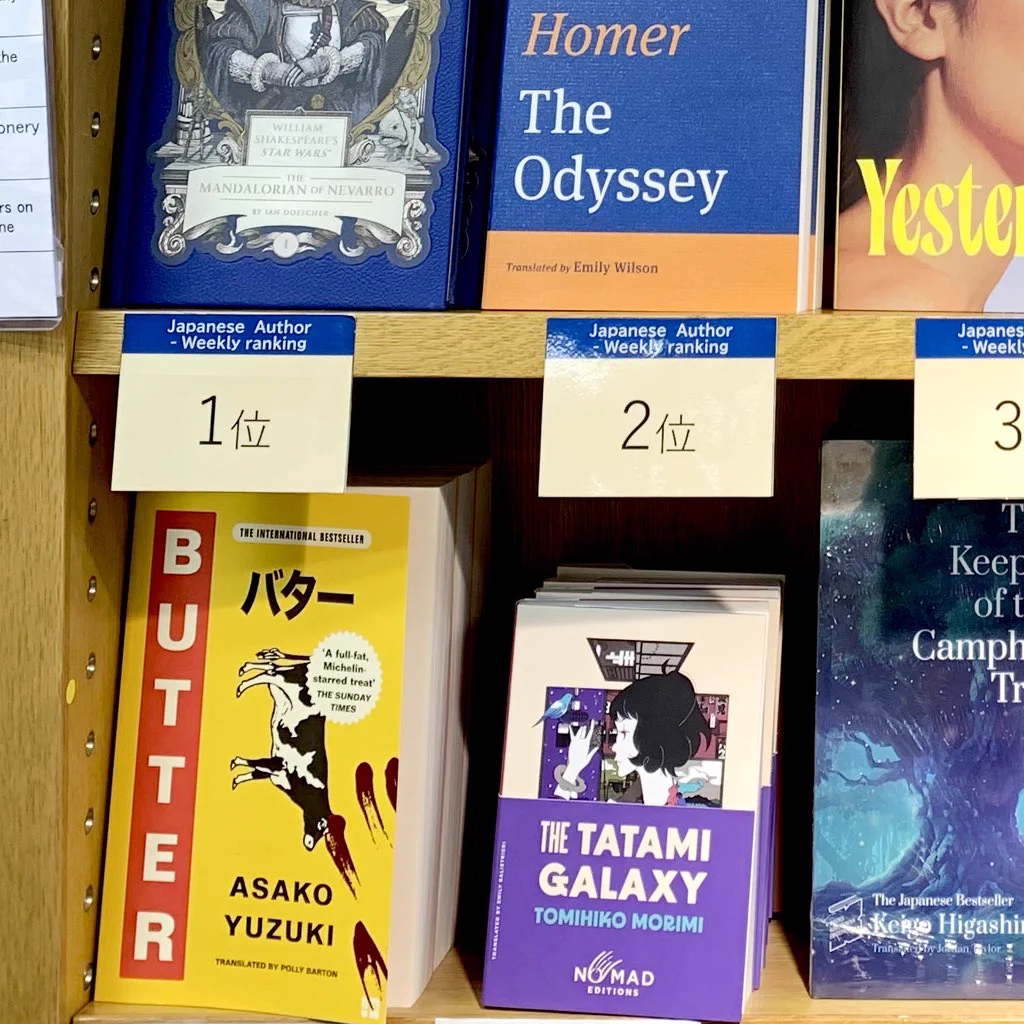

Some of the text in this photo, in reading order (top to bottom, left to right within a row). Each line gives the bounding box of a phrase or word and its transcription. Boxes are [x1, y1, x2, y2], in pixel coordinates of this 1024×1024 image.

[521, 12, 691, 56] Homer
[519, 88, 611, 135] The
[272, 123, 323, 133] WILLIAM
[261, 147, 291, 157] STAR
[199, 182, 395, 197] MANDALORIAN NEVARRO
[514, 154, 728, 215] Odyssey
[506, 260, 659, 275] Translated by Emily Wilson
[167, 318, 311, 336] Japanese Author
[589, 322, 733, 340] Japanese Author
[180, 336, 307, 353] Weekly ranking
[603, 339, 729, 356] Weekly ranking
[198, 394, 271, 451] 1位
[620, 399, 696, 455] 2位
[240, 528, 364, 544] THE INTERNATIONAL BESTSELLER
[240, 569, 354, 620] バター
[974, 587, 1007, 618] of
[335, 649, 369, 661] full-fat,
[323, 662, 367, 673] Michelin-
[313, 675, 347, 686] starred
[317, 690, 372, 702] THE SUNDAY
[331, 704, 356, 713] TIMES
[133, 528, 202, 962] BUTTER
[540, 820, 712, 862] THE TATAMI
[229, 876, 333, 906] ASAKO
[538, 862, 708, 904] GALAXY
[872, 893, 1014, 910] The Japanese Bestseller
[534, 907, 704, 933] TOMIHIKO MORIMI
[872, 912, 932, 939] Keigo
[224, 914, 334, 946] YUZUKI
[215, 958, 338, 978] TRANSLATED POLLY BARTON
[587, 986, 640, 997] EDITIONS
